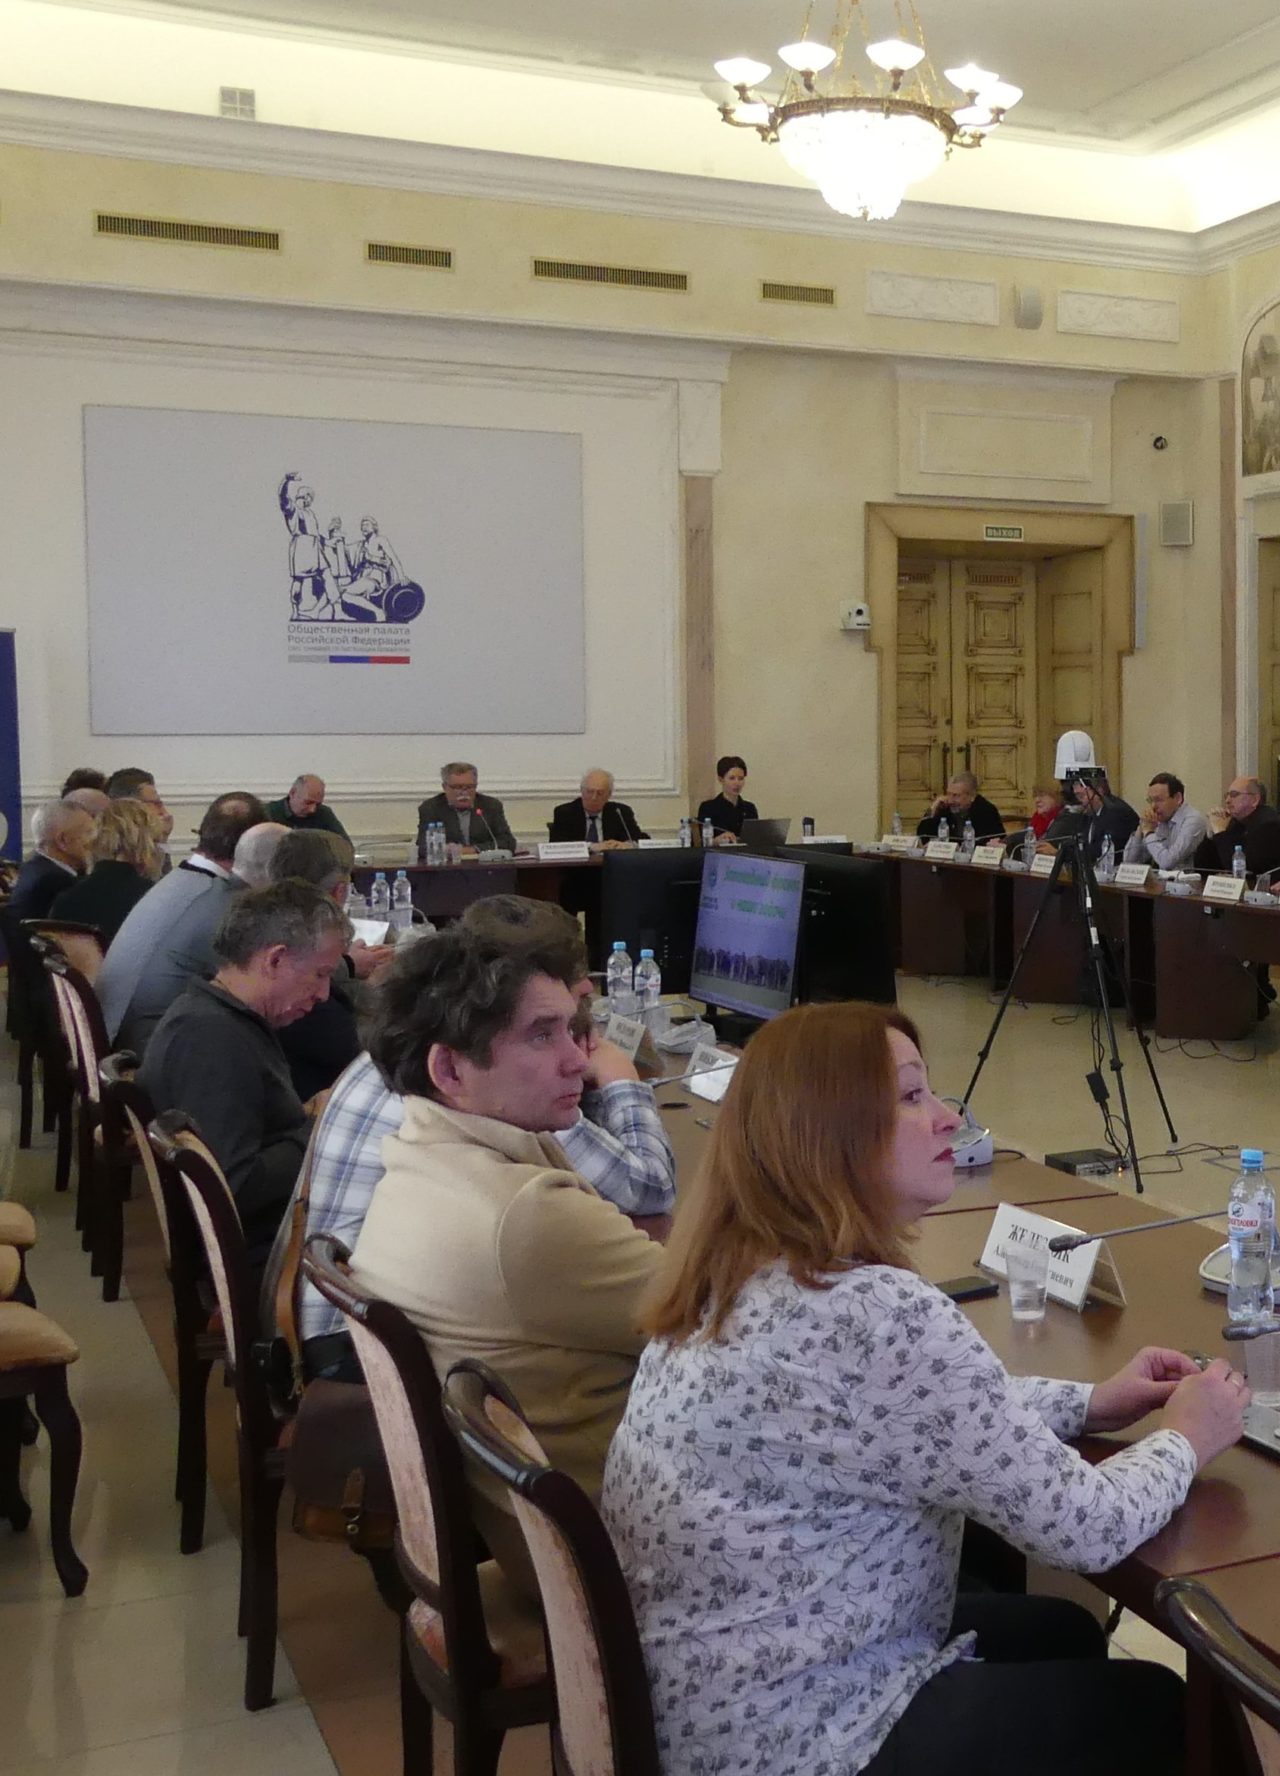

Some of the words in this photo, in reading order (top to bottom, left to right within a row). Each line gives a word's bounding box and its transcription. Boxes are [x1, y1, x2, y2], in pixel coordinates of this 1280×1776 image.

[288, 624, 370, 635] Общественная
[373, 626, 410, 635] палата
[288, 635, 349, 645] Российской
[353, 636, 410, 646] Федерации
